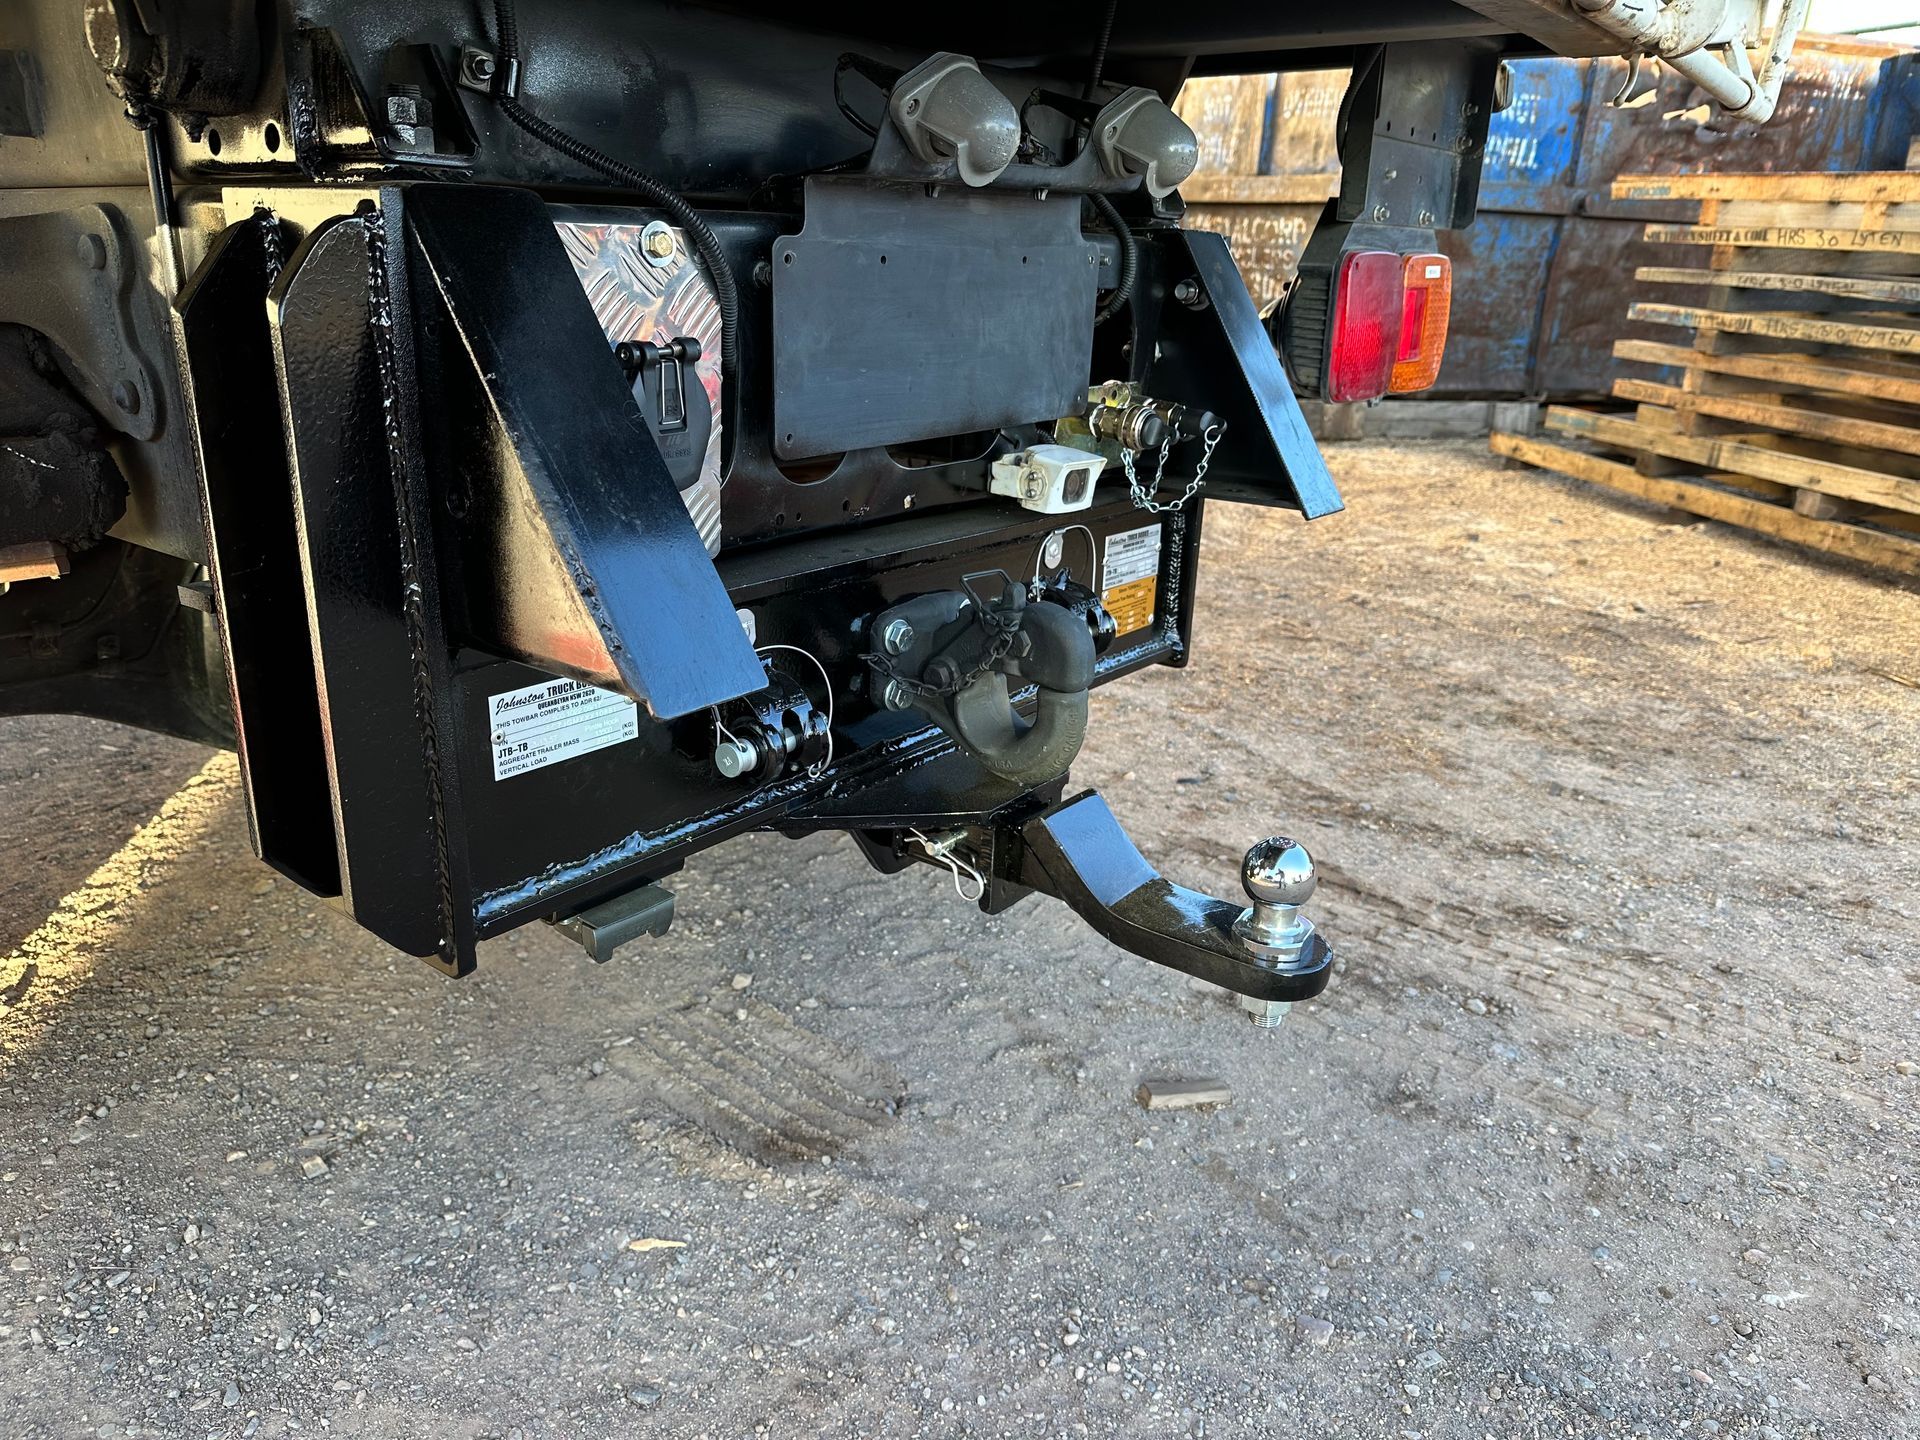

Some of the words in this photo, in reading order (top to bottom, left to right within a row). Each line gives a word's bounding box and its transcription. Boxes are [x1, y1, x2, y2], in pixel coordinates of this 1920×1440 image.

[1777, 228, 1806, 246] HRS
[496, 691, 545, 716] Johnston
[547, 680, 575, 698] TRUCK
[496, 720, 511, 729] THIS
[512, 712, 540, 725] TOWBAR
[539, 703, 571, 718] COMPLIES
[571, 701, 579, 709] TO
[580, 697, 593, 707] ADR
[568, 692, 583, 703] NSW
[499, 751, 537, 767] AGGREGATE
[537, 742, 562, 755] TRAILER
[563, 737, 580, 748] MASS
[622, 720, 635, 730] (KG)
[499, 762, 530, 776] VERTICAL
[531, 756, 548, 767] LOAD
[622, 729, 635, 738] (KG)
